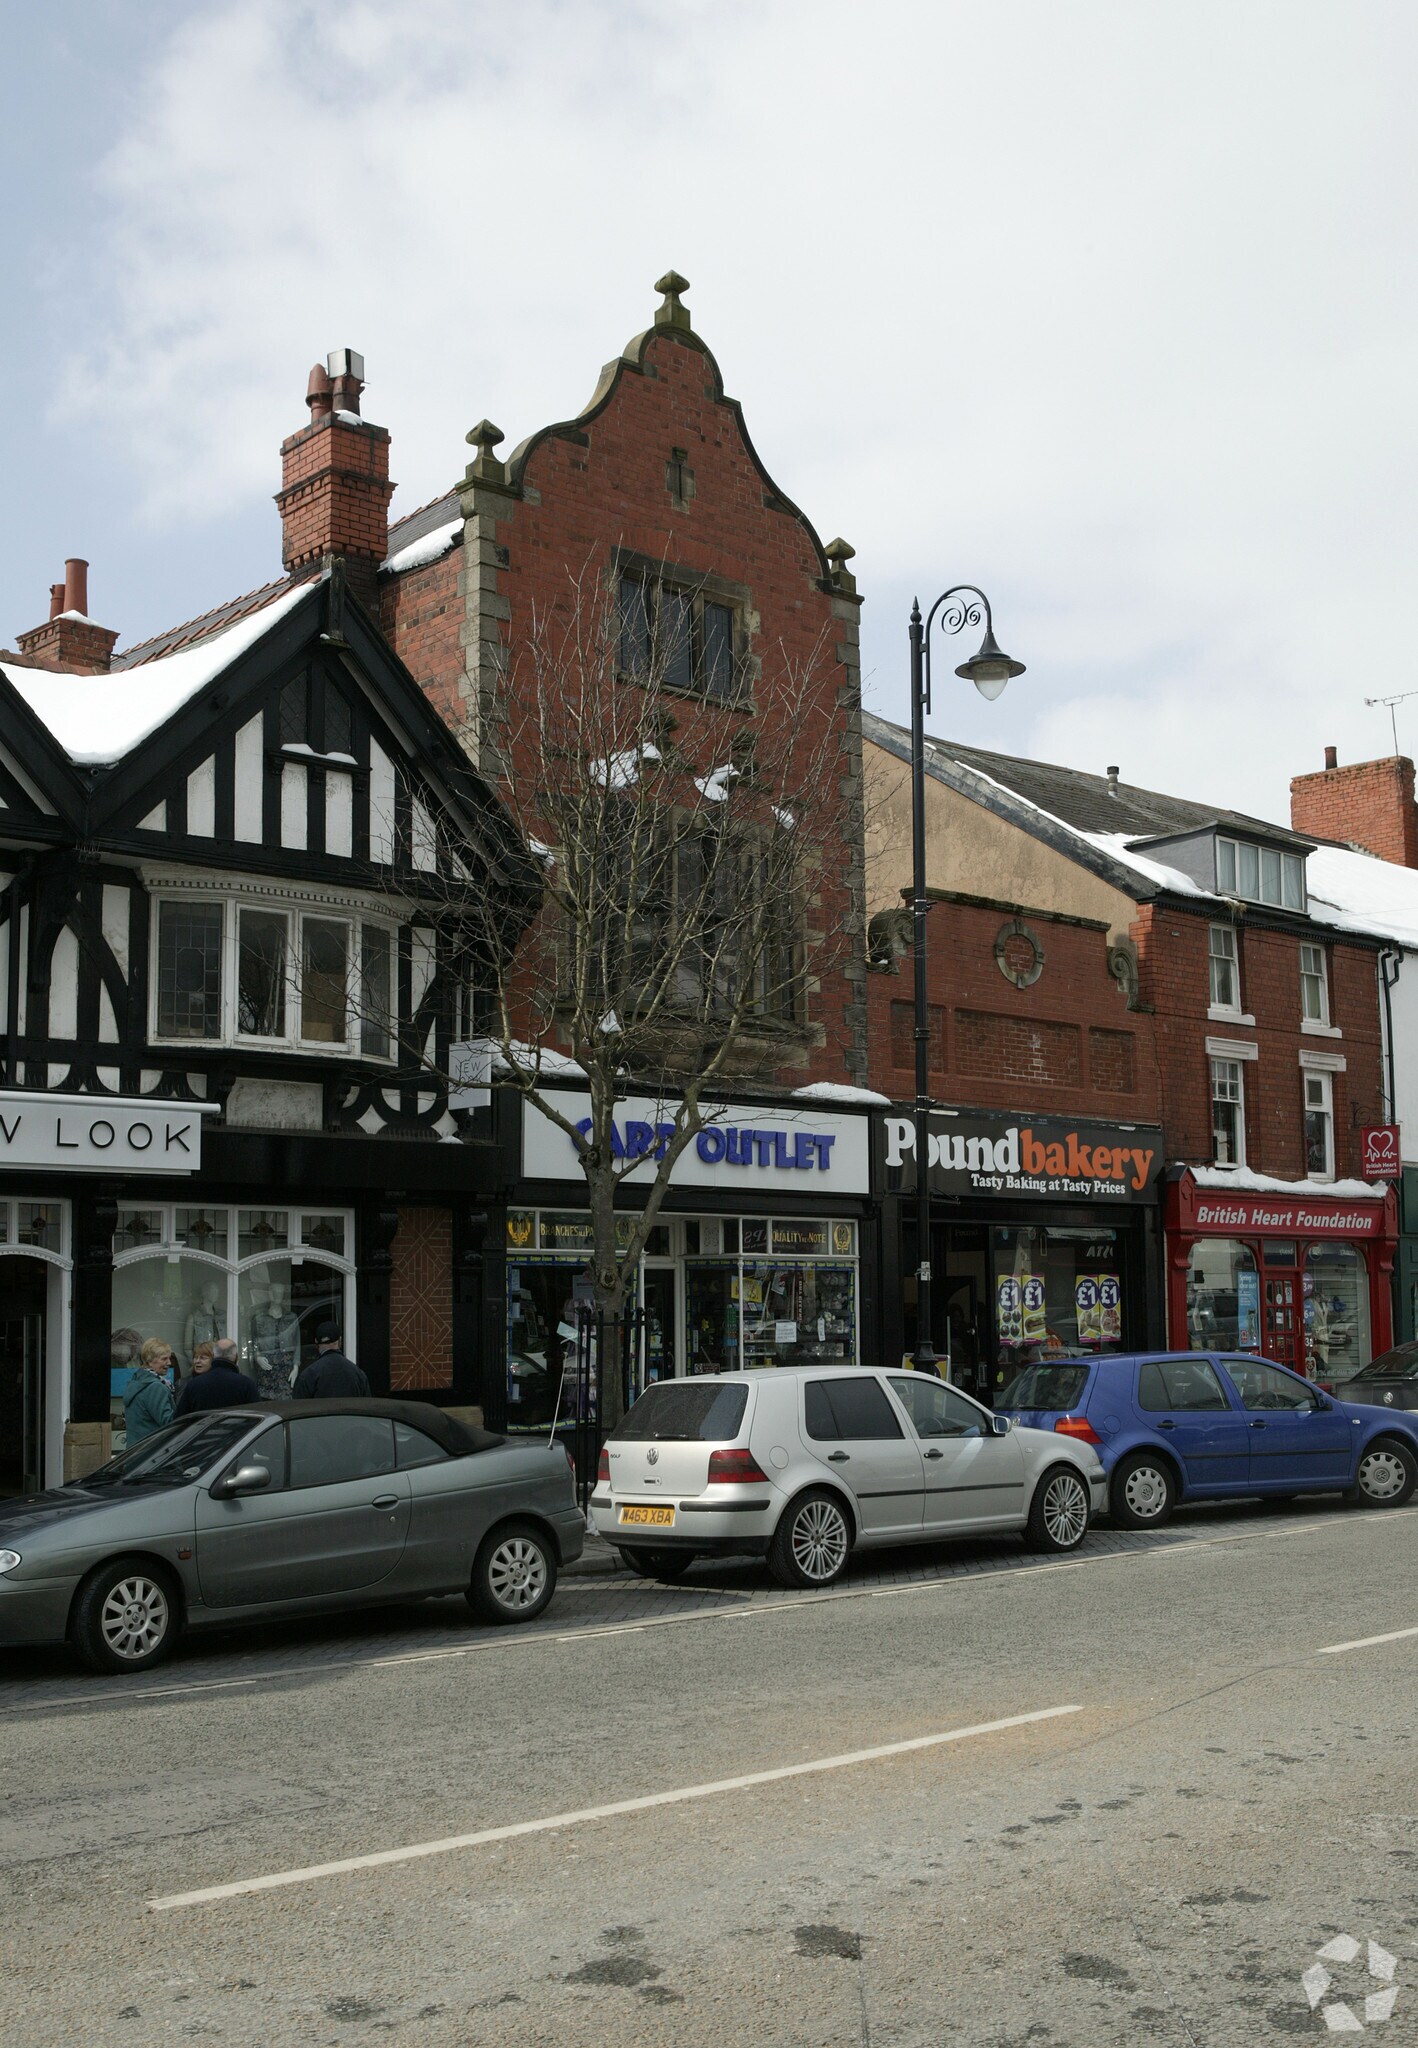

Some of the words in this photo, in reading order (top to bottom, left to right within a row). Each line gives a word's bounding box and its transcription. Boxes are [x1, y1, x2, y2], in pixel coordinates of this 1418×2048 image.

[455, 1061, 481, 1074] NEW
[57, 1117, 190, 1152] LOOK
[696, 1127, 836, 1171] OUTLET
[971, 1173, 1003, 1190] Tasty
[1006, 1176, 1047, 1193] Baking
[1048, 1180, 1061, 1191] at
[1061, 1178, 1091, 1195] Tasty
[1093, 1181, 1126, 1195] Prices
[1196, 1206, 1247, 1224] British
[1251, 1208, 1292, 1226] Heart
[1296, 1210, 1372, 1229] Foundation
[772, 1230, 803, 1243] QUALITY
[1000, 1286, 1019, 1306] £1
[1025, 1286, 1042, 1306] £1
[1077, 1286, 1096, 1305] £1
[1100, 1285, 1118, 1304] £1
[622, 1510, 648, 1523] W463
[649, 1511, 671, 1524] XBA
